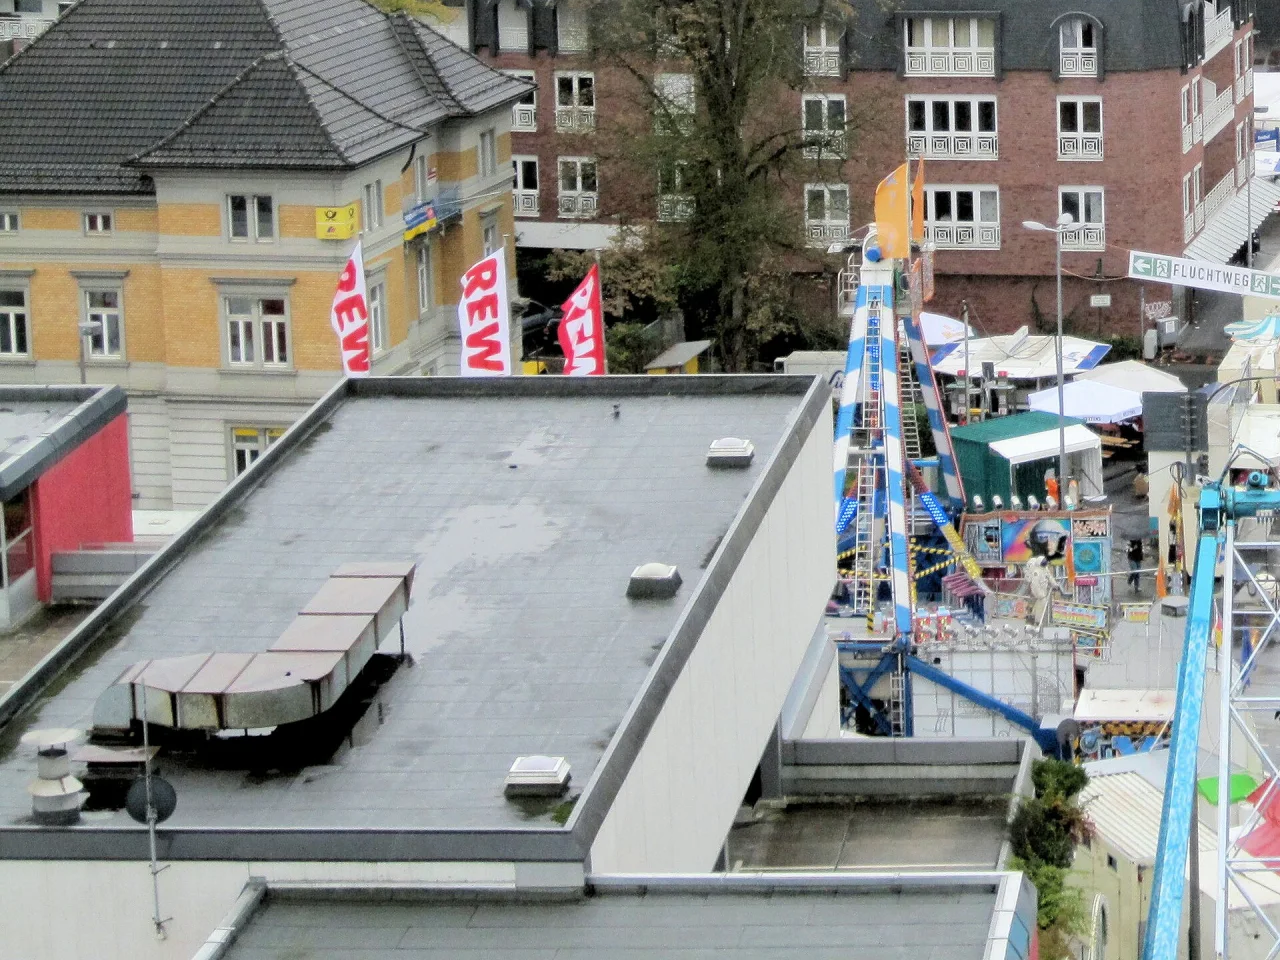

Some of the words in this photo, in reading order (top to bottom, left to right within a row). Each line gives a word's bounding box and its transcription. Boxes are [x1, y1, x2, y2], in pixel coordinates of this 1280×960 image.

[336, 258, 371, 373] REW
[464, 257, 505, 373] REW
[565, 274, 597, 375] REW
[1172, 263, 1250, 288] FLUCHTWEG
